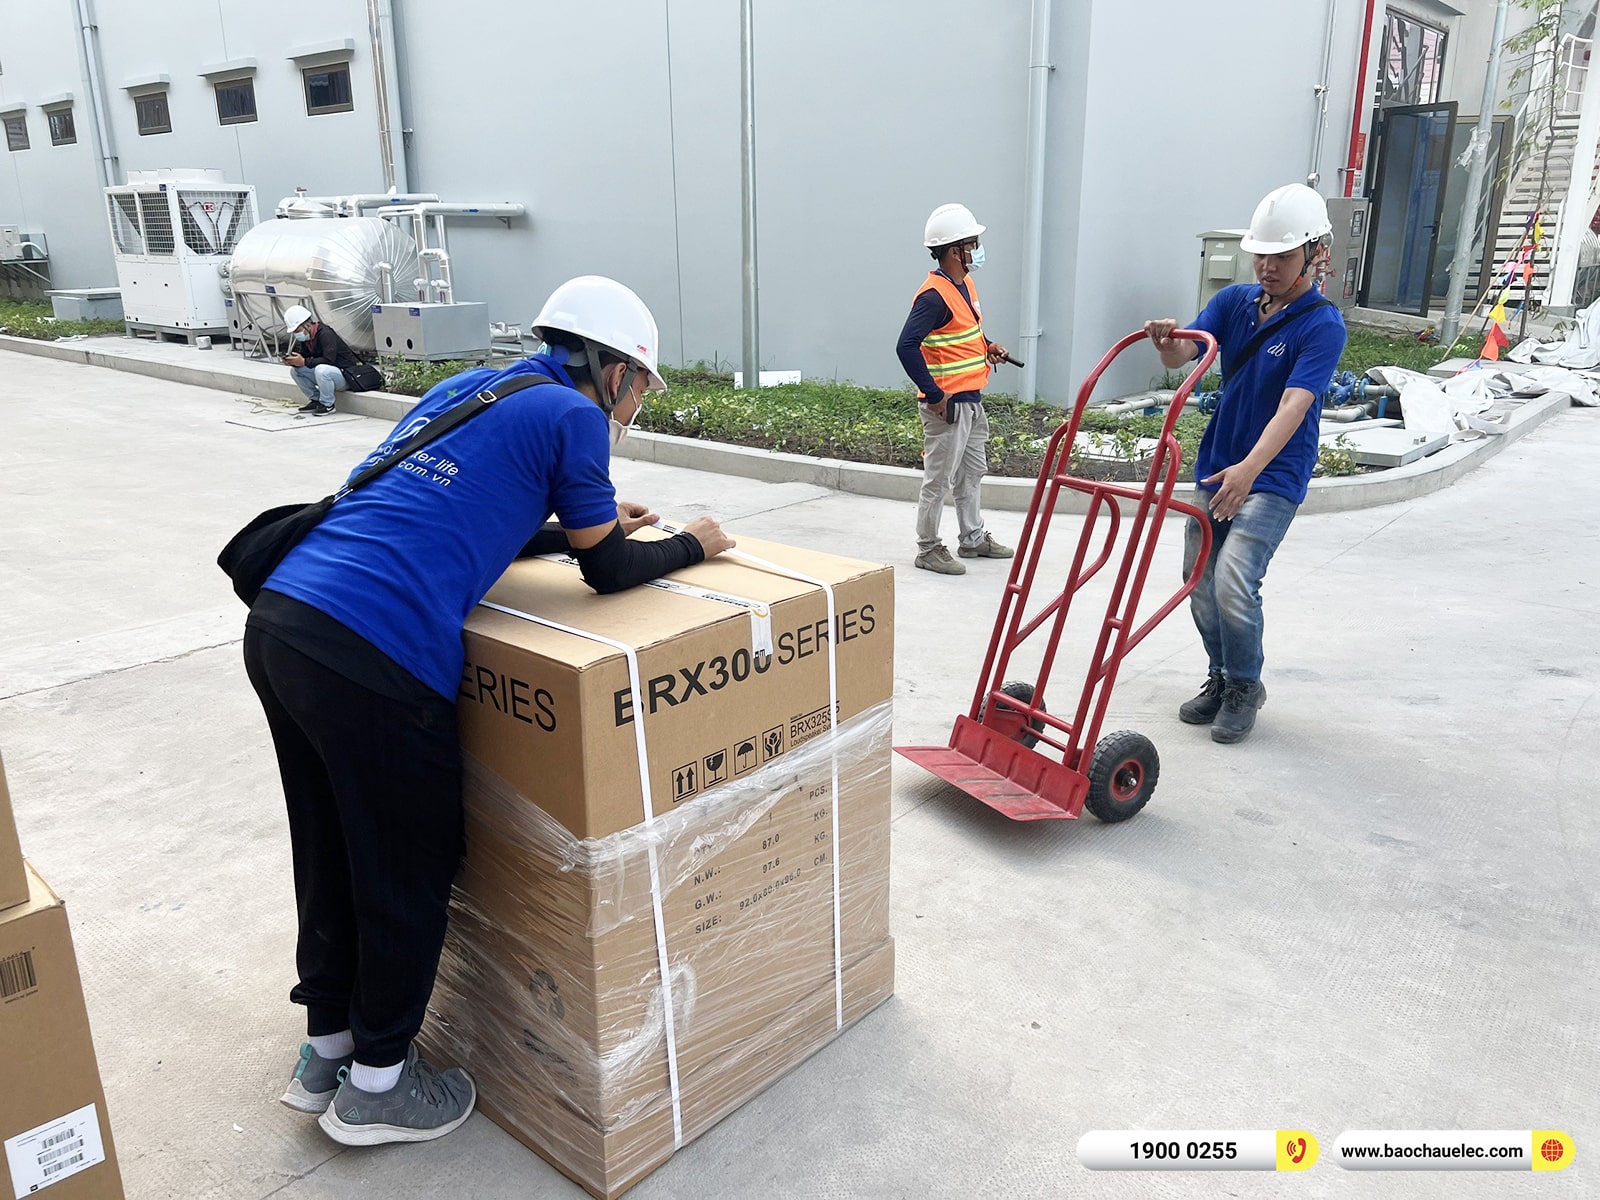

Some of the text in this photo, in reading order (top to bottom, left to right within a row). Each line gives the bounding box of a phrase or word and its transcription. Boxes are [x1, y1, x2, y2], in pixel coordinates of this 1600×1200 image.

[434, 459, 459, 475] life
[777, 604, 876, 665] SERIES
[460, 661, 557, 732] ERIES
[694, 808, 828, 886] N.W.: 87.0 KG.
[695, 831, 828, 910] G.W.: 97.6 KG.
[695, 914, 722, 934] SIZE:
[813, 853, 828, 866] CM.
